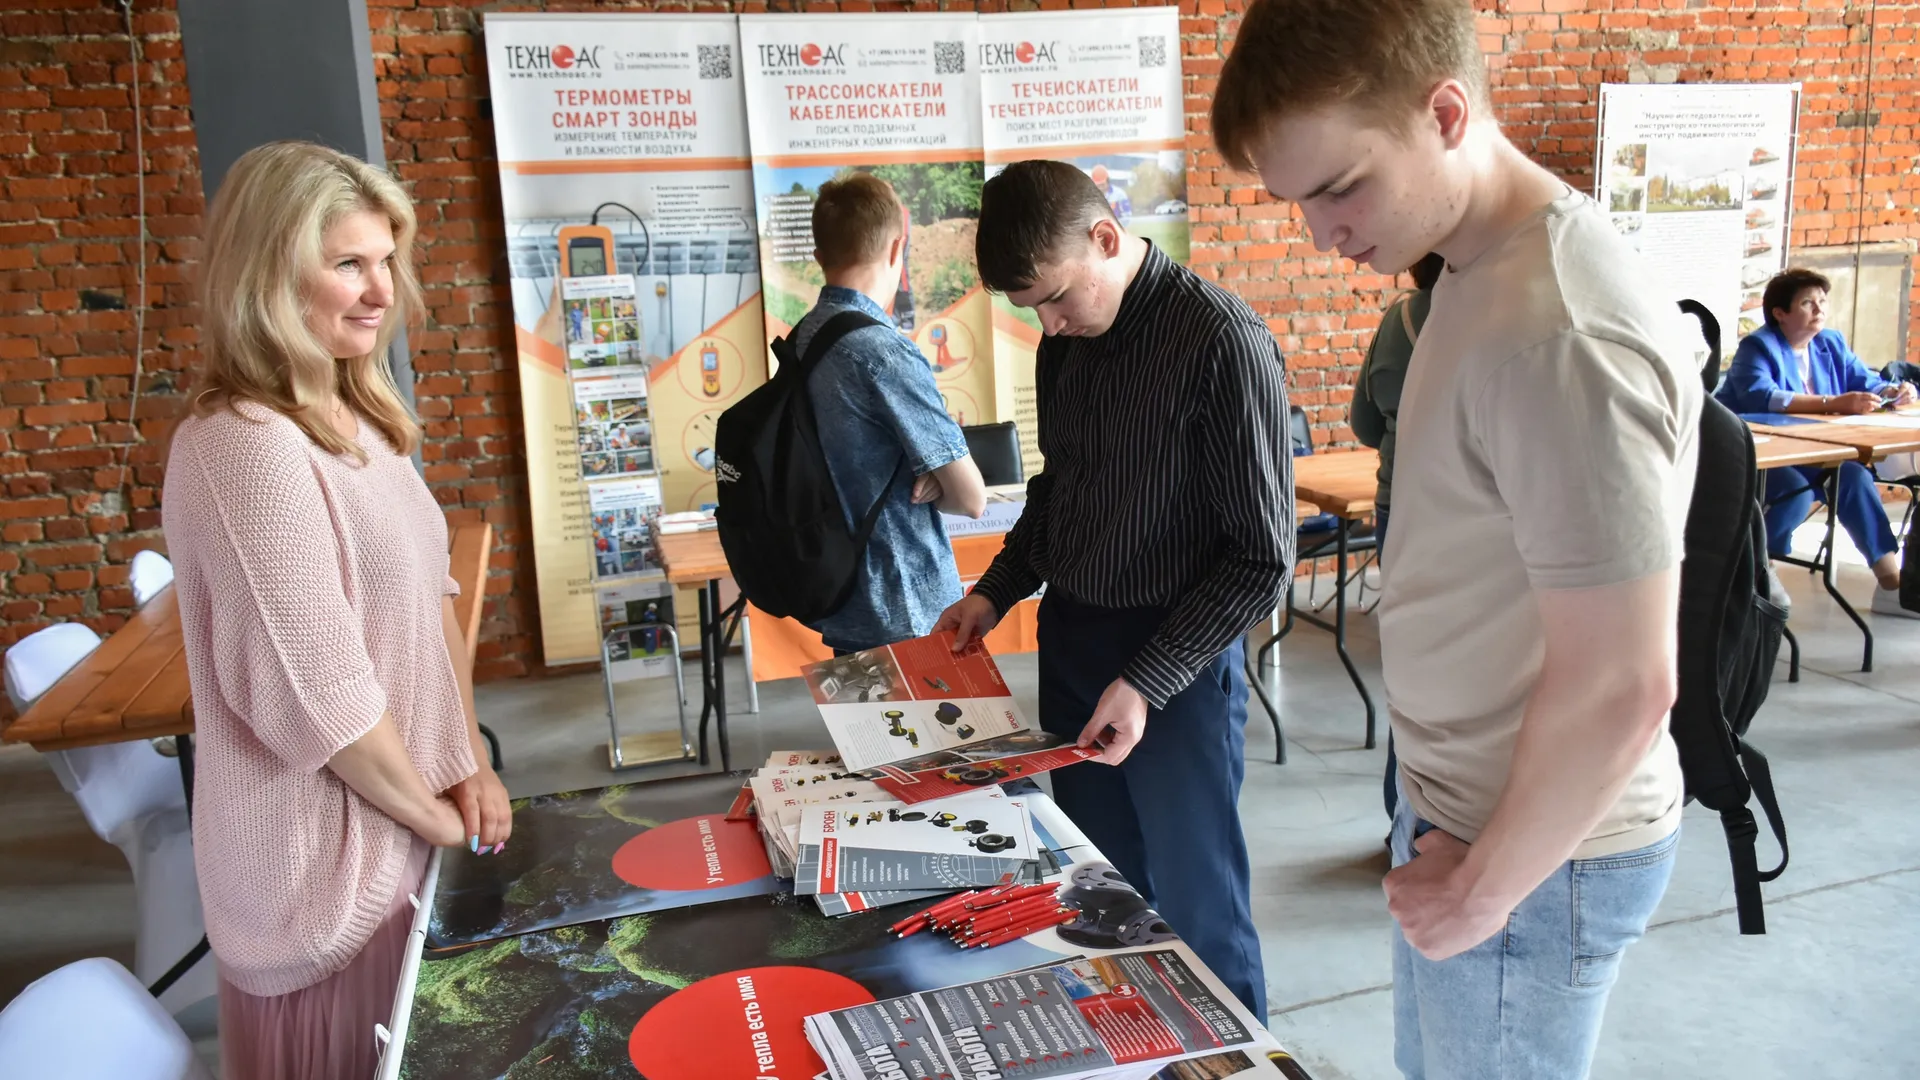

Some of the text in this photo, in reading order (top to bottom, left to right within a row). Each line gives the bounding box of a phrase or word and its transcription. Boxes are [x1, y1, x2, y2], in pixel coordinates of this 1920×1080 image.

[509, 71, 602, 79] www.technoac.ru
[555, 89, 692, 106] ТЕРМОМЕТРЫ
[785, 83, 942, 100] ТРАССОИСКАТЕЛИ
[1012, 77, 1139, 98] ТЕЧЕИСКАТЕЛИ
[790, 102, 946, 120] КАБЕЛЕИСКАТЕЛИ
[989, 96, 1163, 118] ТЕЧЕТРАССОИСКАТЕЛИ
[552, 111, 697, 129] СМАРТ ЗОНДЫ
[816, 124, 916, 135] ПОИСК ПОДЗЕМНЫХ
[1006, 116, 1147, 131] ПОИСК МЕСТ РАЗГЕРМЕТИЗАЦИИ
[554, 130, 697, 142] ИЗМЕРЕНИЕ ТЕМПЕРАТУРЫ
[788, 135, 947, 148] ИНЖЕНЕРНЫХ КОММУНИКАЦИЙ
[1017, 128, 1139, 144] ИЗ ЛЮБЫХ ТРУБОПРОВОДОВ
[565, 145, 692, 156] И ВЛАЖНОСТИ ВОЗДУХА
[699, 818, 713, 834] имя
[823, 810, 836, 833] БРОЕН
[702, 834, 716, 851] есть
[705, 852, 722, 875] тепла
[737, 975, 756, 1001] имя
[979, 982, 1002, 1002] Слесарь
[1004, 978, 1027, 999] Технолог
[1025, 974, 1045, 990] Токарь
[962, 986, 978, 999] пилах
[743, 1002, 765, 1030] есть
[874, 1003, 889, 1017] пилах
[892, 999, 911, 1018] Слесарь
[972, 1005, 993, 1024] Резчик
[1029, 1004, 1052, 1025] станков
[885, 1022, 904, 1042] Резчик
[1013, 1009, 1052, 1055] Работник склада
[1052, 1003, 1092, 1047] Электросварщик
[999, 1020, 1034, 1058] Фрезеровщик
[1043, 1024, 1070, 1051] Оператор
[753, 1031, 776, 1073] тепла
[915, 1035, 947, 1073] Фрезеровщик
[948, 1026, 1004, 1080] РАБОТА
[992, 1041, 1015, 1061] Маляр
[865, 1043, 909, 1080] БОТА
[908, 1058, 929, 1078] Маляр
